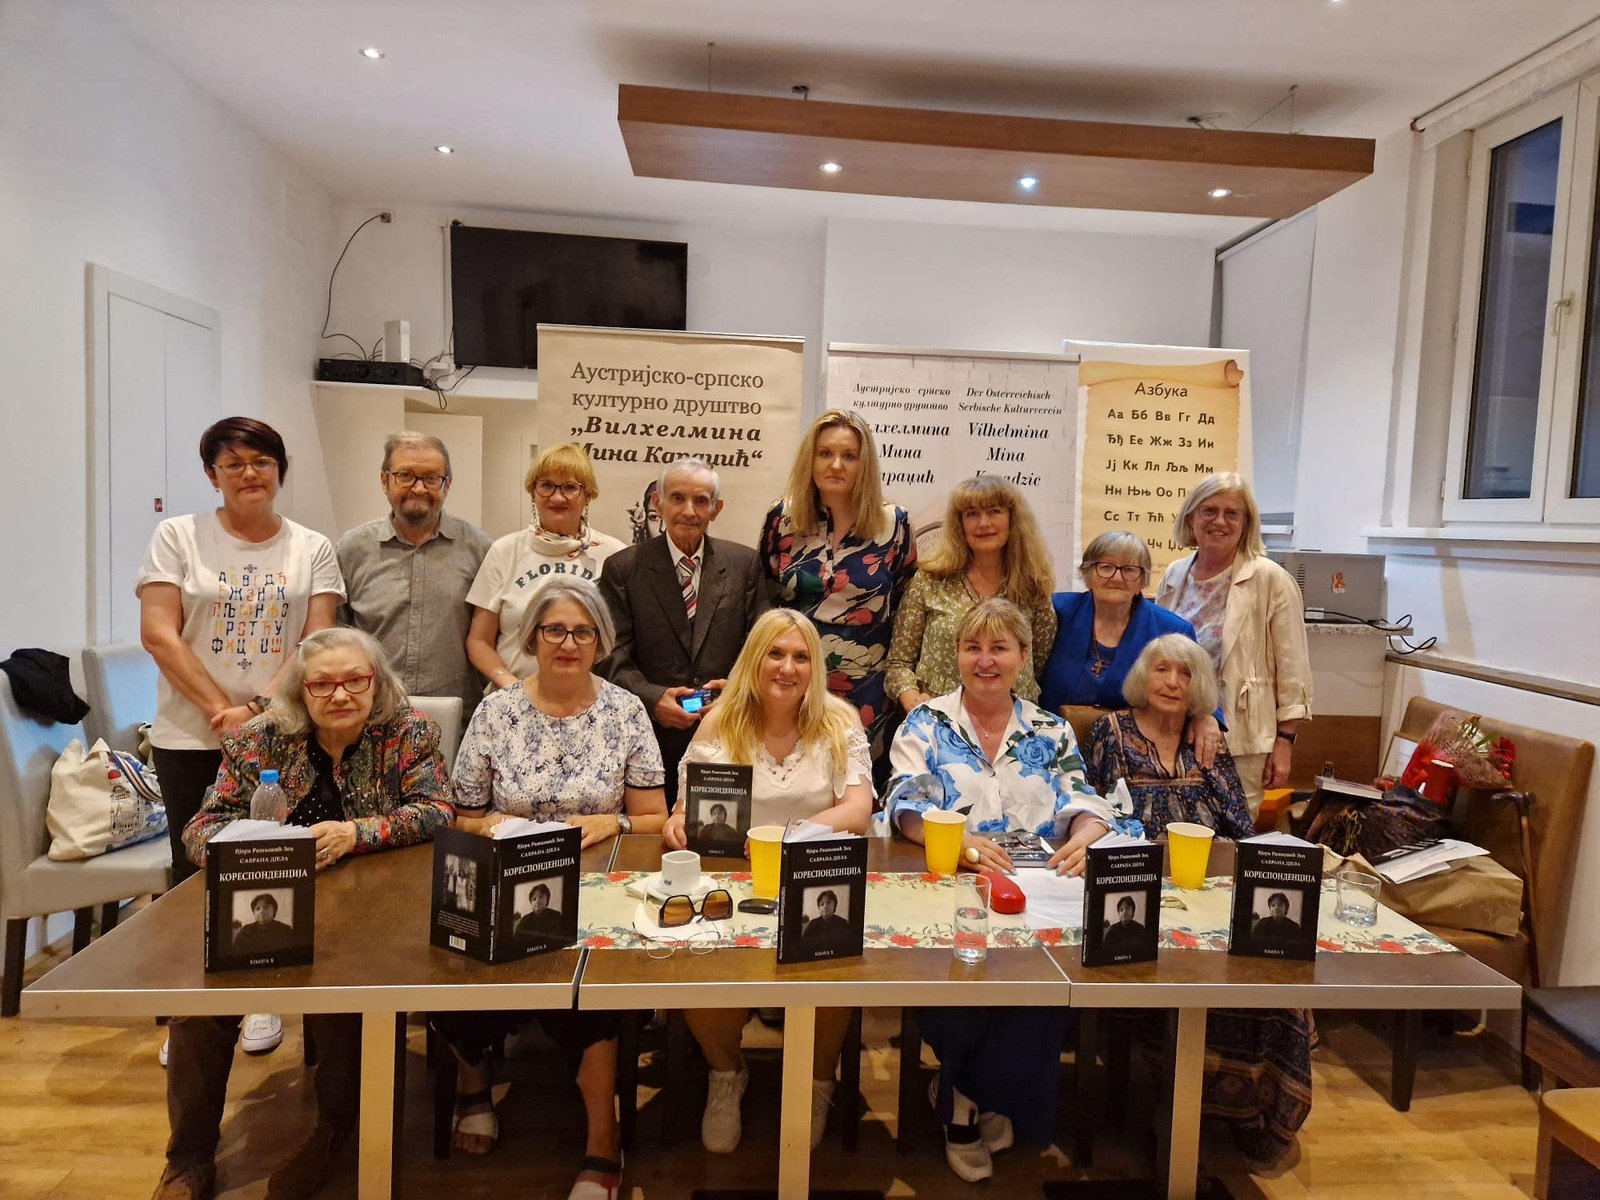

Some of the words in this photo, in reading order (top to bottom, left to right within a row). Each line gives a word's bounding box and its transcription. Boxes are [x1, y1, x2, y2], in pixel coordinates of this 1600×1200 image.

[570, 361, 764, 390] Аустријско-српско
[853, 383, 910, 396] Аустријско
[918, 387, 951, 398] српско
[966, 387, 984, 397] Der
[1134, 382, 1188, 399] Азбука
[571, 393, 668, 413] културно
[673, 398, 762, 416] друштво
[853, 400, 902, 411] културно
[958, 402, 1001, 412] Serbische
[1003, 404, 1062, 415] Kulturverein
[1107, 408, 1124, 419] Аа
[1131, 409, 1148, 420] Бб
[1155, 410, 1171, 421] Вв
[1178, 412, 1191, 422] Гг
[1197, 413, 1215, 425] Дд
[570, 416, 761, 441] „Вилхелмина
[868, 423, 951, 436] лхелмина
[968, 422, 1049, 439] Vilhelmina
[1107, 434, 1123, 446] Ђђ
[1129, 435, 1144, 445] Ее
[1149, 436, 1172, 446] Жж
[1178, 437, 1193, 448] Зз
[1198, 438, 1214, 448] Ии
[879, 444, 922, 459] Мина
[986, 446, 1025, 462] Mina
[1106, 459, 1117, 472] Јј
[1123, 460, 1138, 470] Кк
[1144, 461, 1160, 471] Лл
[1166, 462, 1189, 472] Љљ
[1194, 463, 1214, 473] Мм
[1105, 484, 1122, 495] Нн
[1127, 485, 1151, 496] Њњ
[1156, 486, 1173, 497] Оо
[1104, 510, 1120, 521] Сс
[1127, 511, 1141, 521] Тт
[1147, 511, 1164, 522] Ћћ
[1147, 538, 1162, 549] Чч
[219, 571, 226, 584] А
[242, 574, 249, 586] В
[229, 587, 242, 601] Ж
[223, 602, 235, 618] Љ
[281, 602, 289, 617] О
[226, 621, 234, 636] Р
[249, 620, 258, 636] Т
[275, 620, 283, 635] У
[211, 636, 223, 654] Ф
[271, 638, 281, 653] Ш
[503, 856, 575, 877] КОРЕСПОНДЕНЦИЈА
[793, 866, 861, 880] КОРЕСПОНДЕНЦИЈА
[219, 868, 307, 883] КОРЕСПОНДЕНЦИЈА
[1096, 873, 1157, 885] КОРЕСПОНДЕНЦИЈА
[1244, 869, 1316, 883] КОРЕСПОНДЕНЦИЈА
